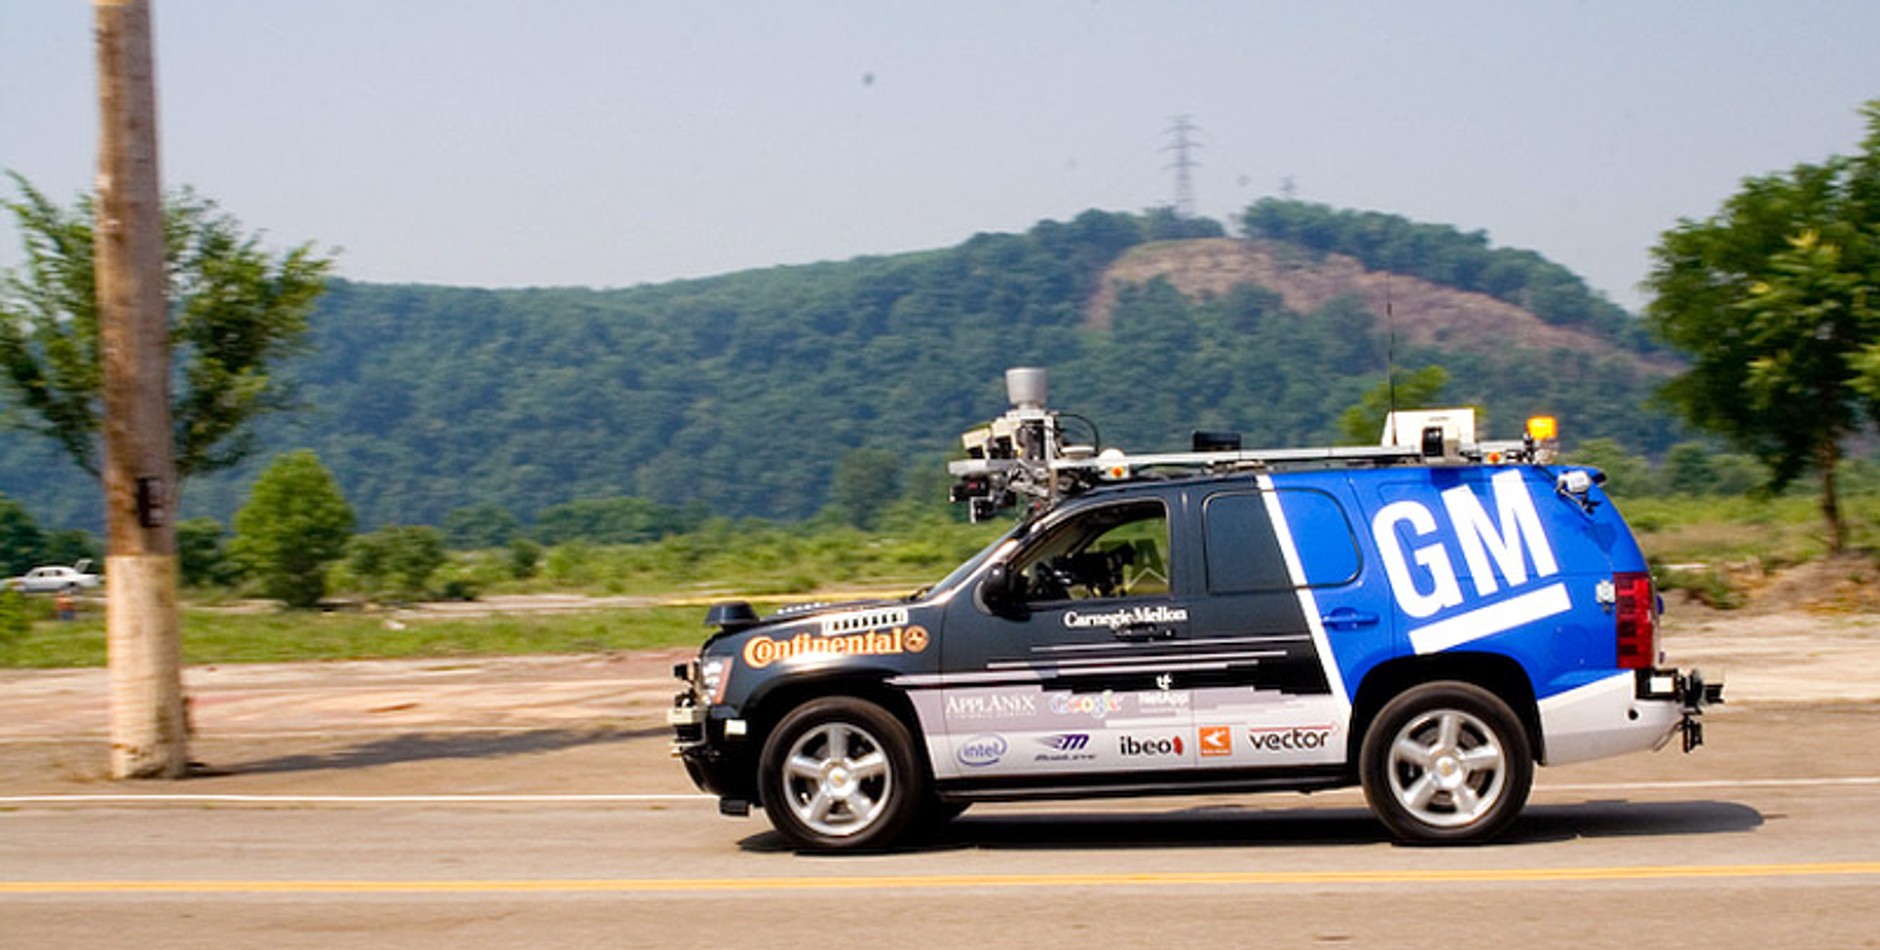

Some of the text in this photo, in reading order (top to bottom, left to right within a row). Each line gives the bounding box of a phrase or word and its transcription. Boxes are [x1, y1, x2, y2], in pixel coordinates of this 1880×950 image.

[1372, 469, 1559, 618] GM
[1064, 606, 1188, 629] Carnegie Mellon
[743, 628, 904, 669] Continental
[1050, 689, 1123, 718] Google
[1120, 736, 1172, 755] ibeo
[1249, 728, 1328, 750] vector
